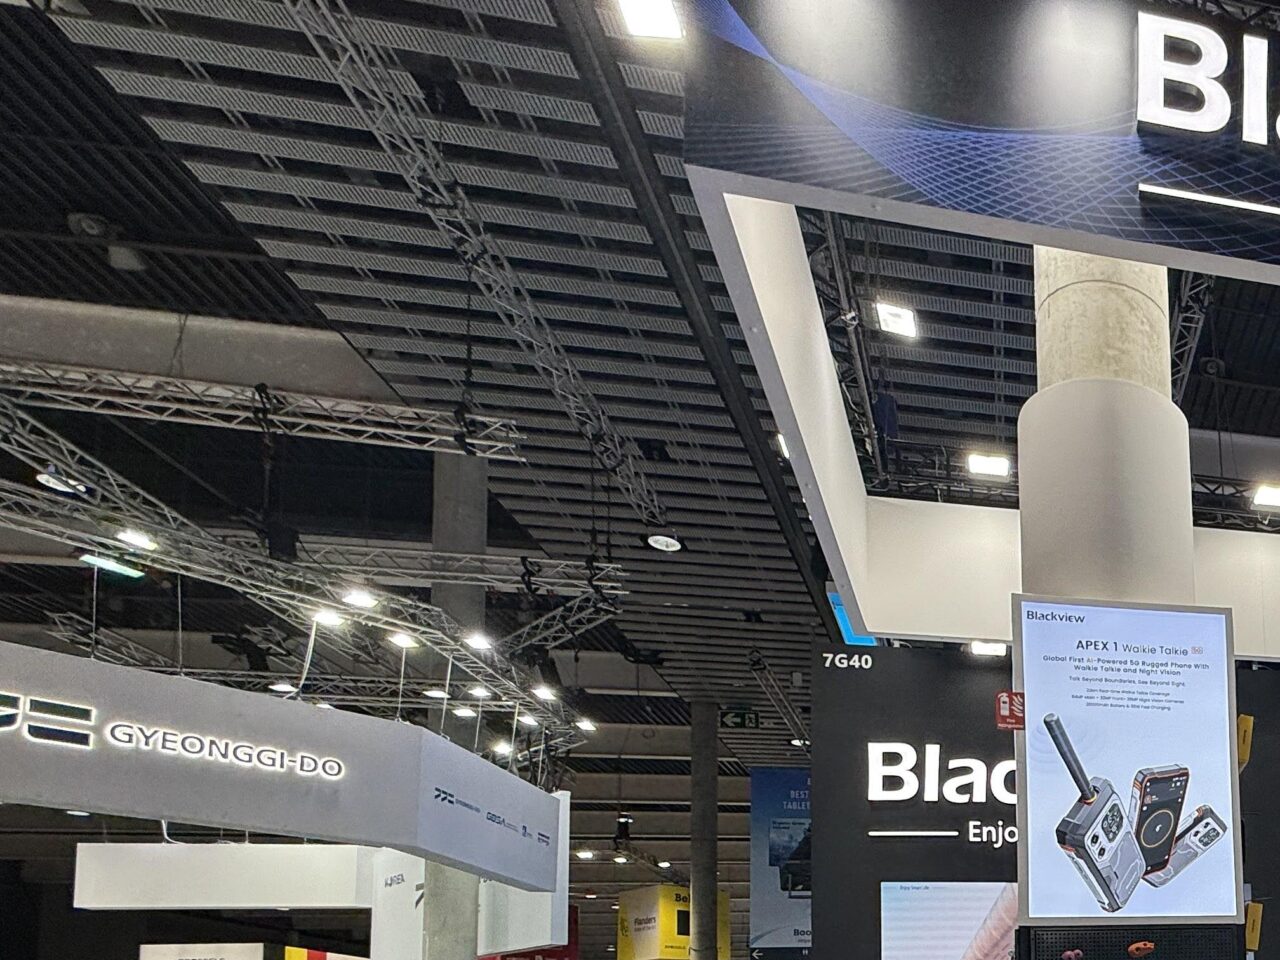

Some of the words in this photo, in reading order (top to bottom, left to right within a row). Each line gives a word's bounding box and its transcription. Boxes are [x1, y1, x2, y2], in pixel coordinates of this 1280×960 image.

[1026, 610, 1085, 623] Blackview
[1076, 640, 1109, 652] APEX
[1113, 641, 1118, 652] 1
[1122, 643, 1157, 655] Walkie
[1159, 645, 1188, 656] Talkie
[822, 653, 873, 669] 7G40
[1142, 659, 1168, 668] Rugged
[1170, 661, 1192, 669] Phone
[1193, 662, 1209, 670] With
[108, 722, 344, 778] GYEONGGI-DO
